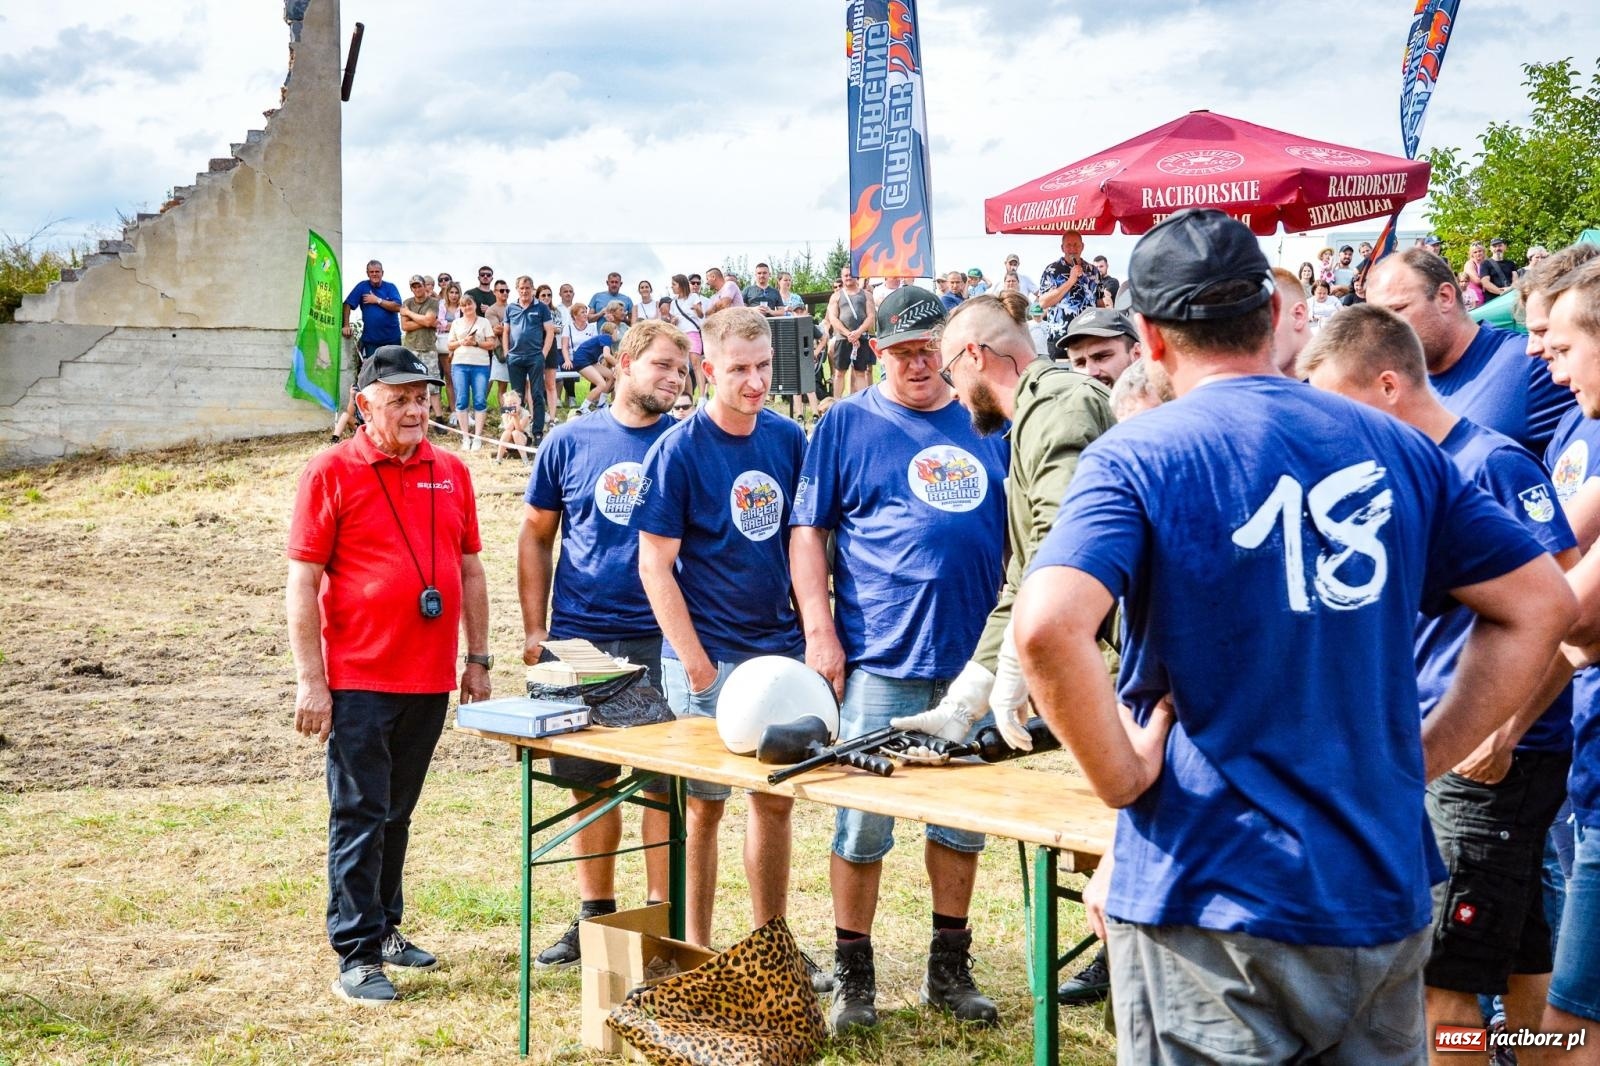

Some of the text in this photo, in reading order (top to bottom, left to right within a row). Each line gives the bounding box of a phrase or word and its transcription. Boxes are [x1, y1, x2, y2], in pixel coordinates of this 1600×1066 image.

[1141, 180, 1260, 208] RACIBORSKIE
[1327, 172, 1408, 198] RACIBORSKIE
[1003, 195, 1079, 225] RACIBORSKIE
[926, 477, 979, 493] CIAPEK
[928, 488, 980, 502] RACING
[605, 504, 633, 513] RAC
[606, 495, 637, 504] CIAP
[742, 512, 779, 532] RACING
[1231, 460, 1394, 613] 18
